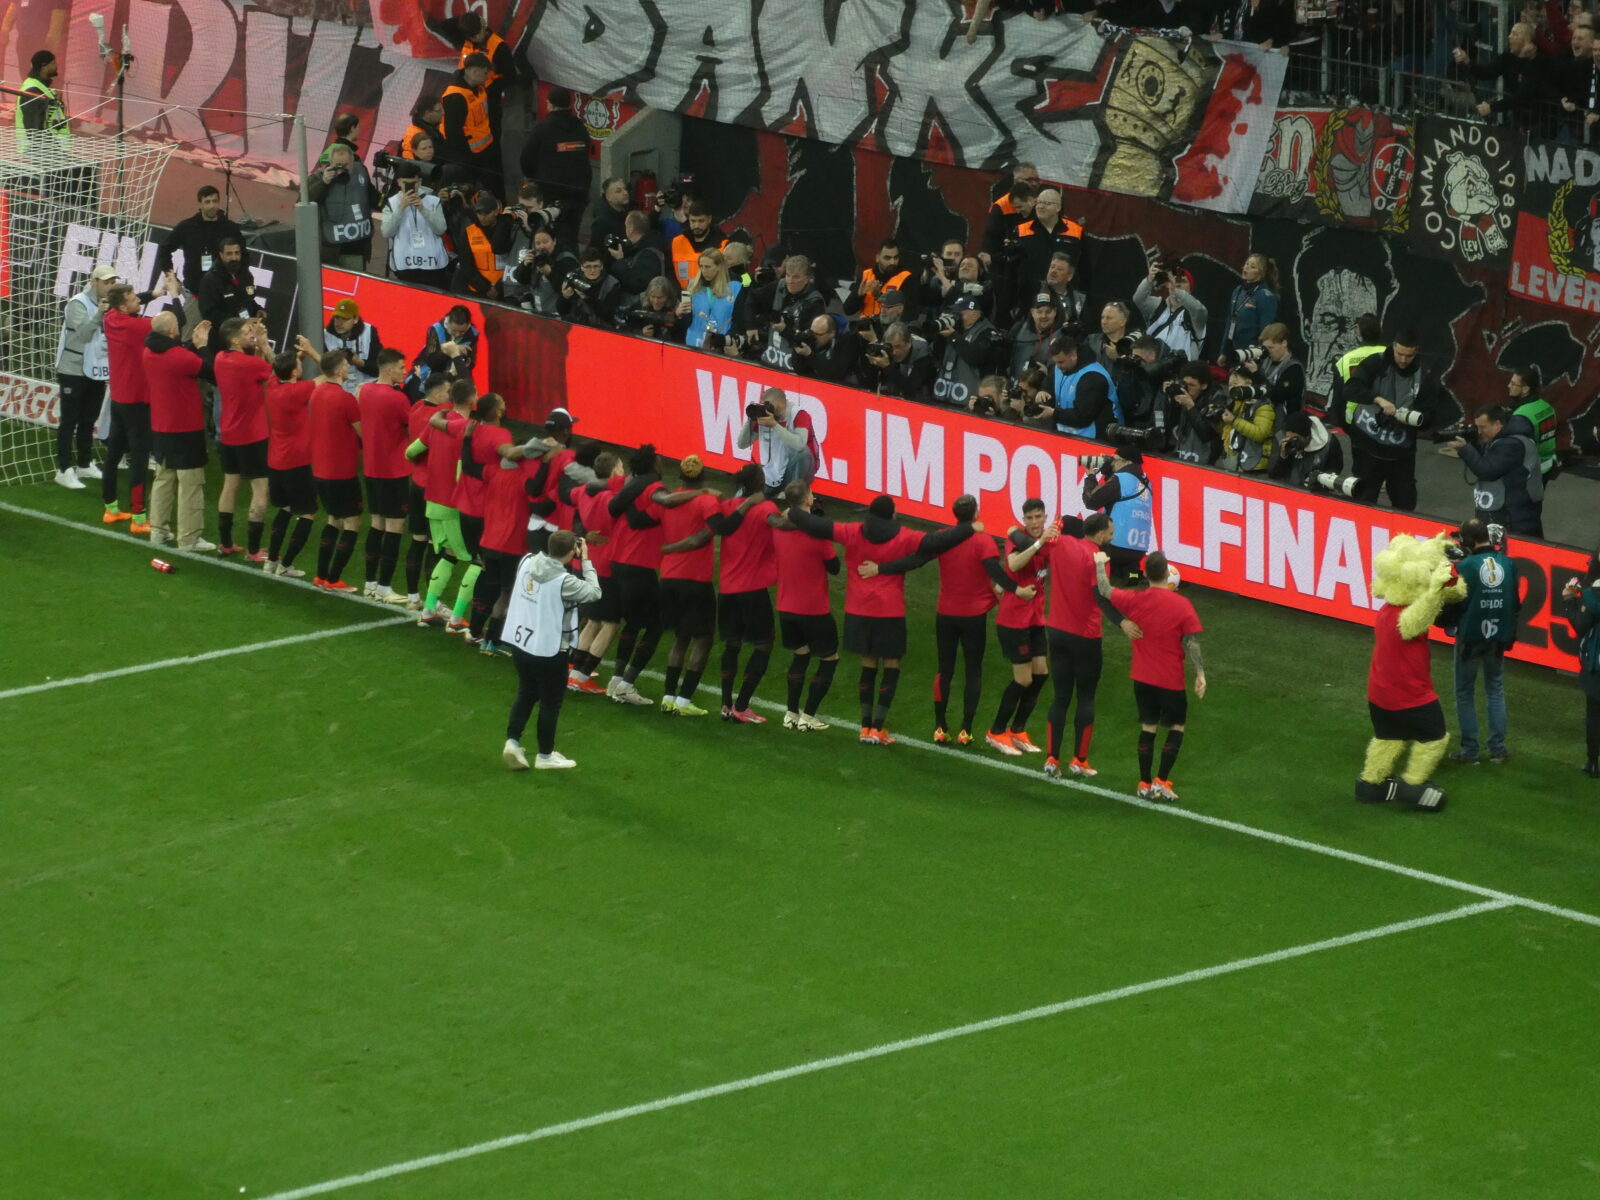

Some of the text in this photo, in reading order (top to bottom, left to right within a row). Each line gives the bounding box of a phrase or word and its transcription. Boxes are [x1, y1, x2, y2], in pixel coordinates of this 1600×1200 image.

[1375, 158, 1414, 183] BAYER
[1420, 124, 1516, 249] COMMANDO 1989
[1373, 195, 1398, 213] 04
[333, 218, 371, 242] FOTO
[865, 408, 945, 508] IM
[1127, 527, 1146, 548] 01
[514, 625, 535, 647] 67
